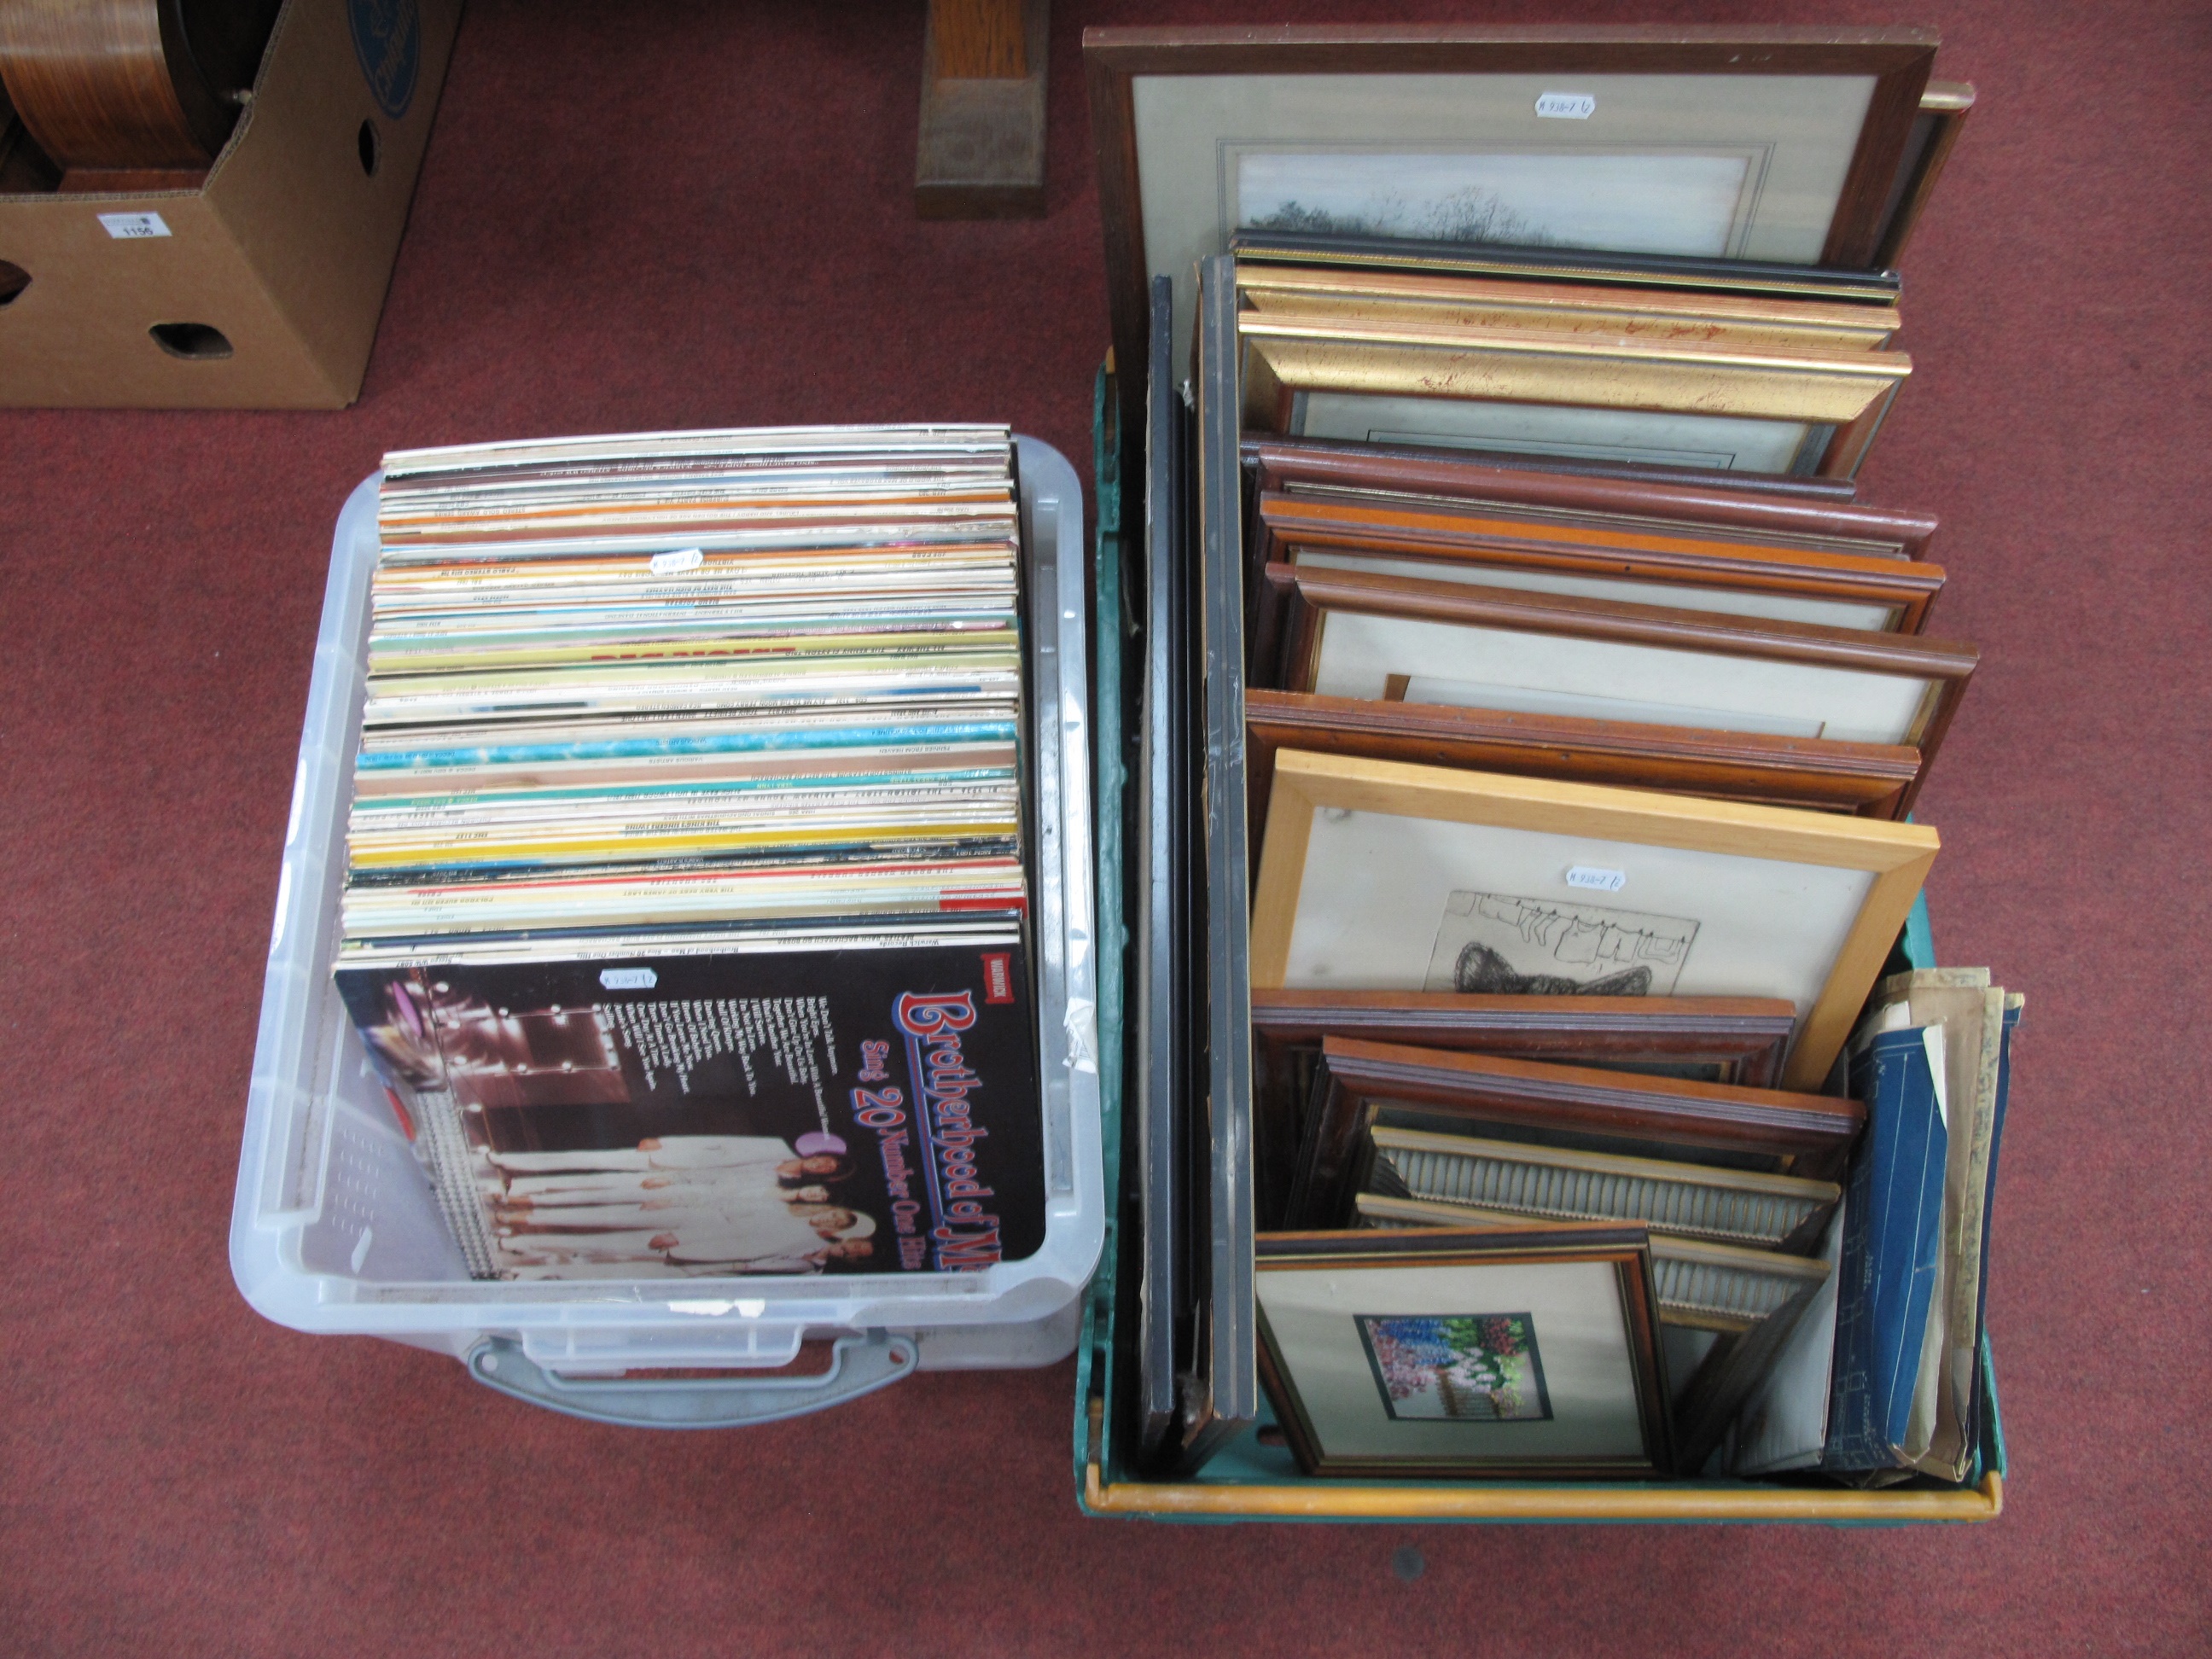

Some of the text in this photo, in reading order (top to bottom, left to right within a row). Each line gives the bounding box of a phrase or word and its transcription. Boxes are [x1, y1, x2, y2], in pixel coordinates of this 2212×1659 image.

[637, 1002, 646, 1018] One
[990, 958, 1007, 998] WARWICK
[849, 1039, 925, 1270] Sing 20 Number One Hits
[891, 990, 994, 1199] Brotherhood
[951, 1202, 999, 1227] of
